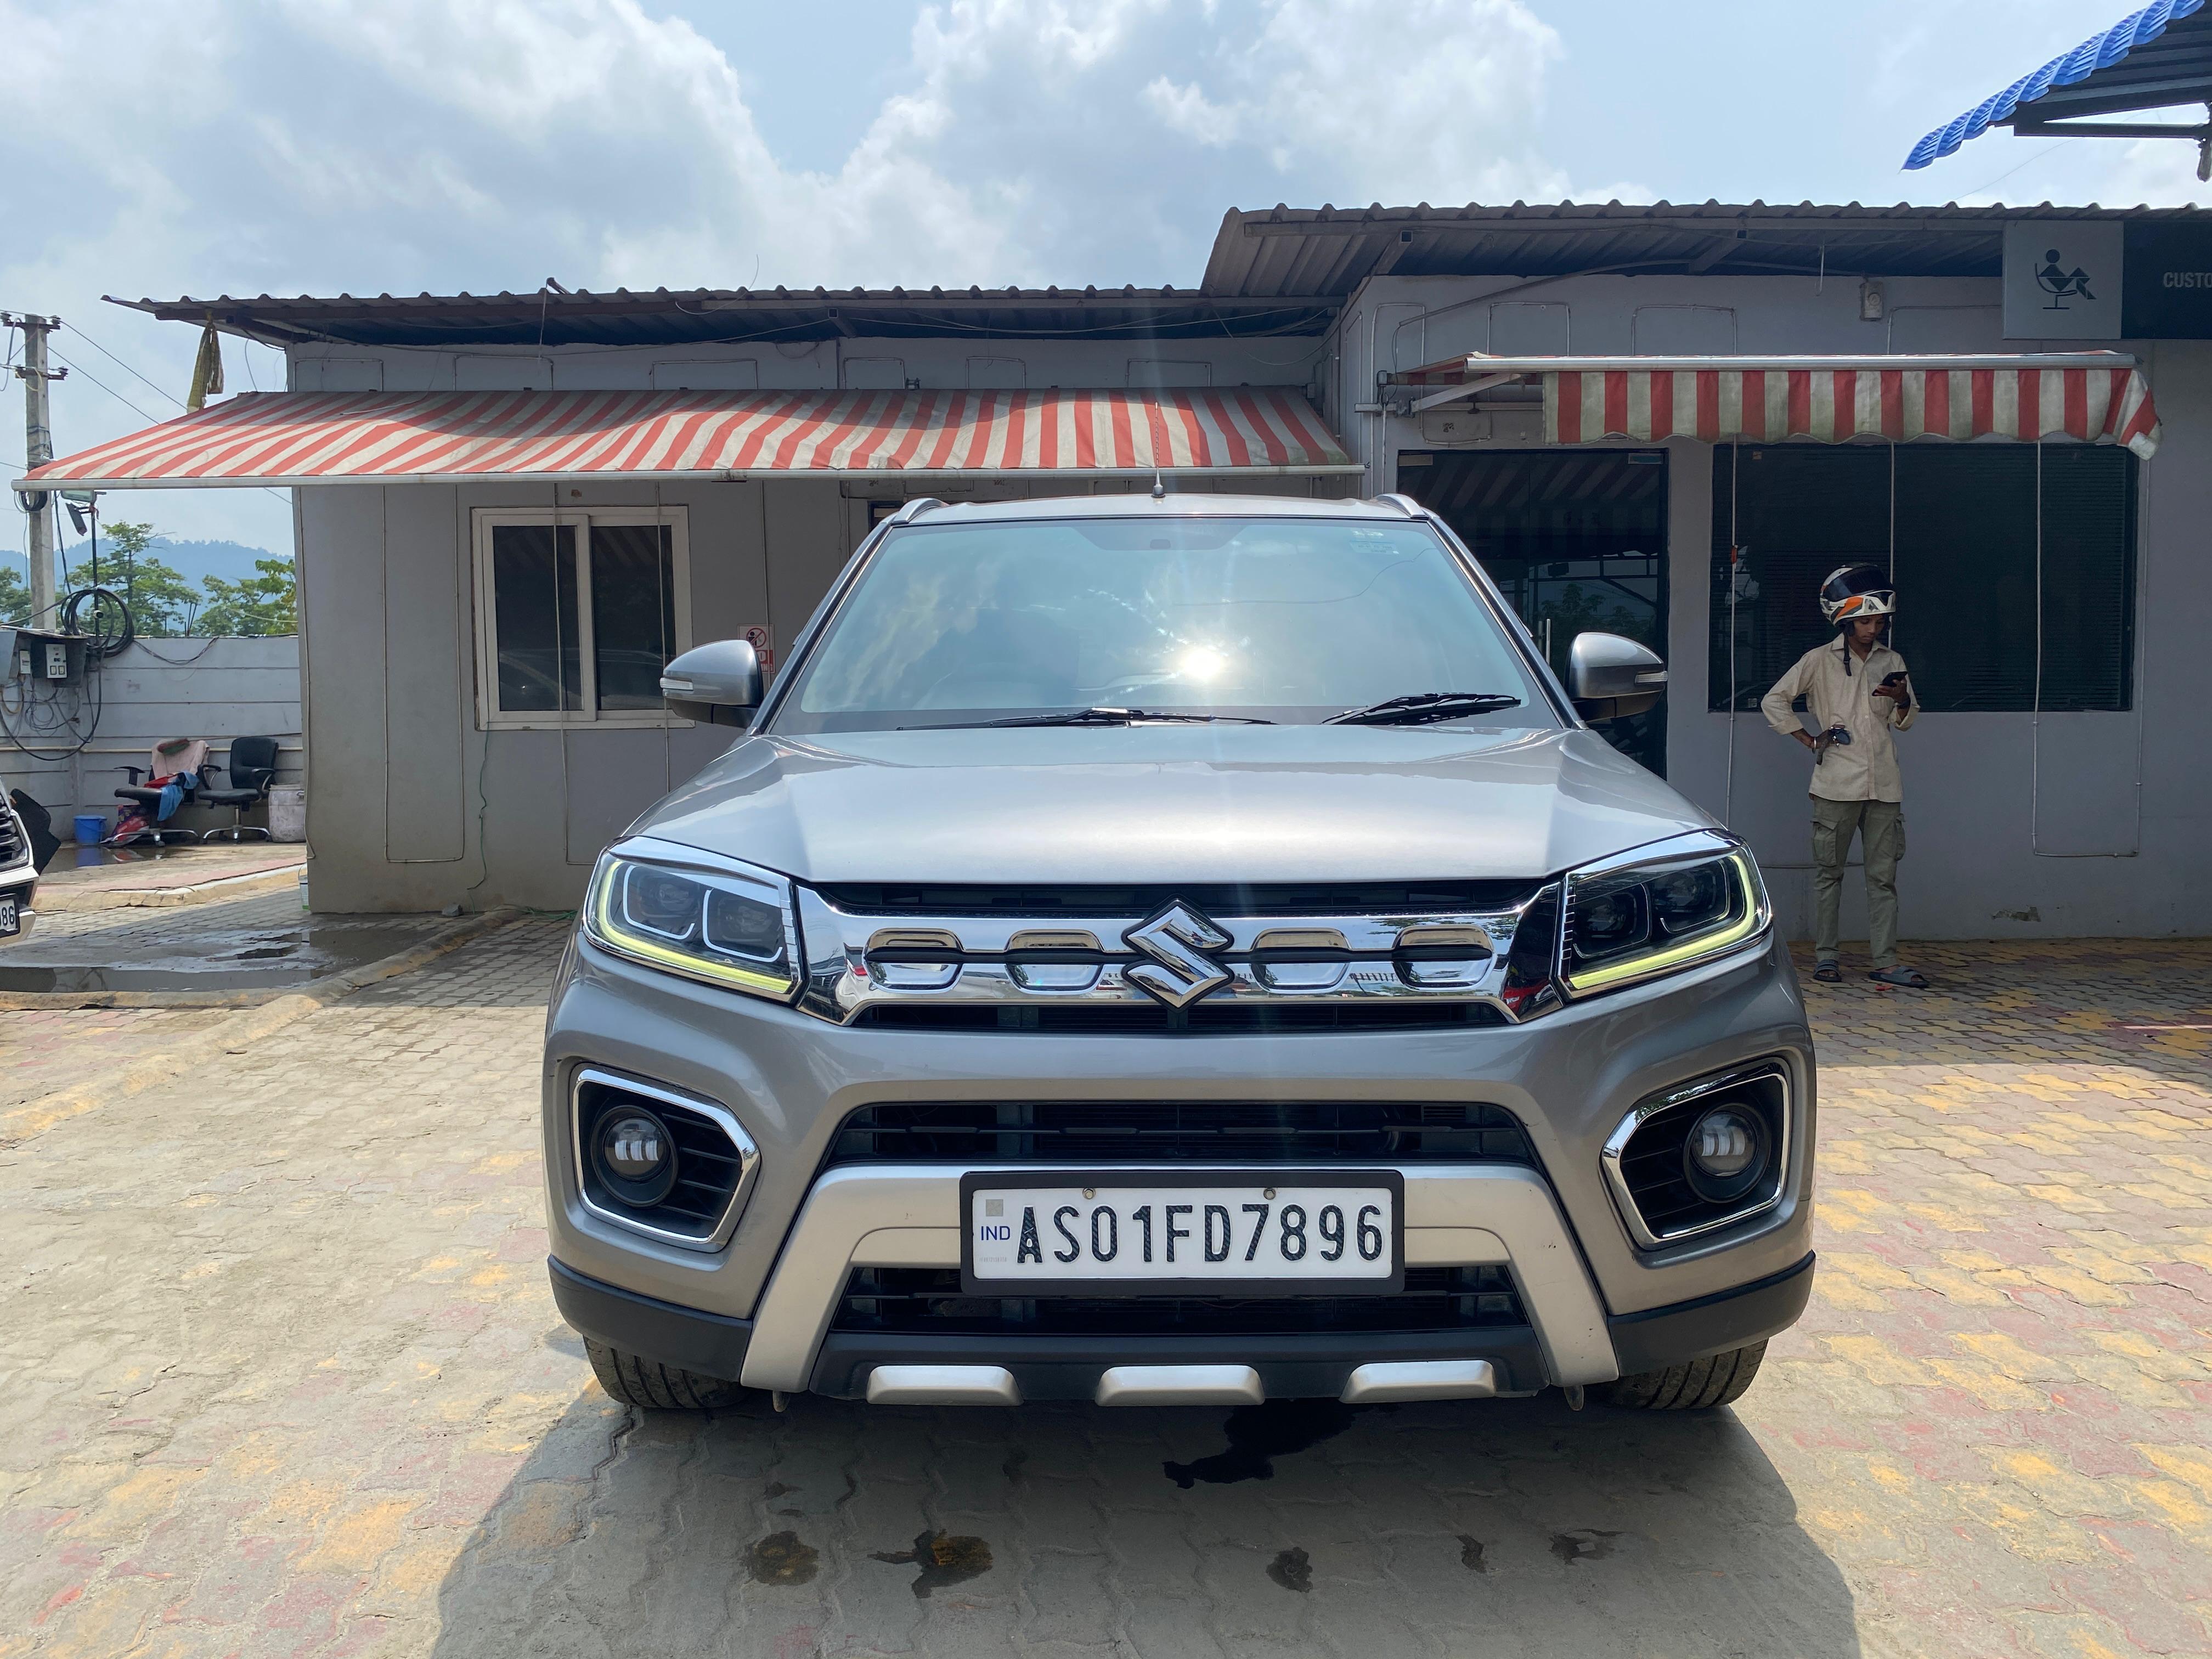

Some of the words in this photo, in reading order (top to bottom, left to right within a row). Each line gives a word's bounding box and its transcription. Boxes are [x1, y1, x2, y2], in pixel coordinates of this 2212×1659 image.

[2163, 272, 2212, 288] CUSTO
[0, 906, 15, 926] 86
[981, 1226, 1011, 1240] IND
[1017, 1204, 1383, 1263] AS01FD7896
